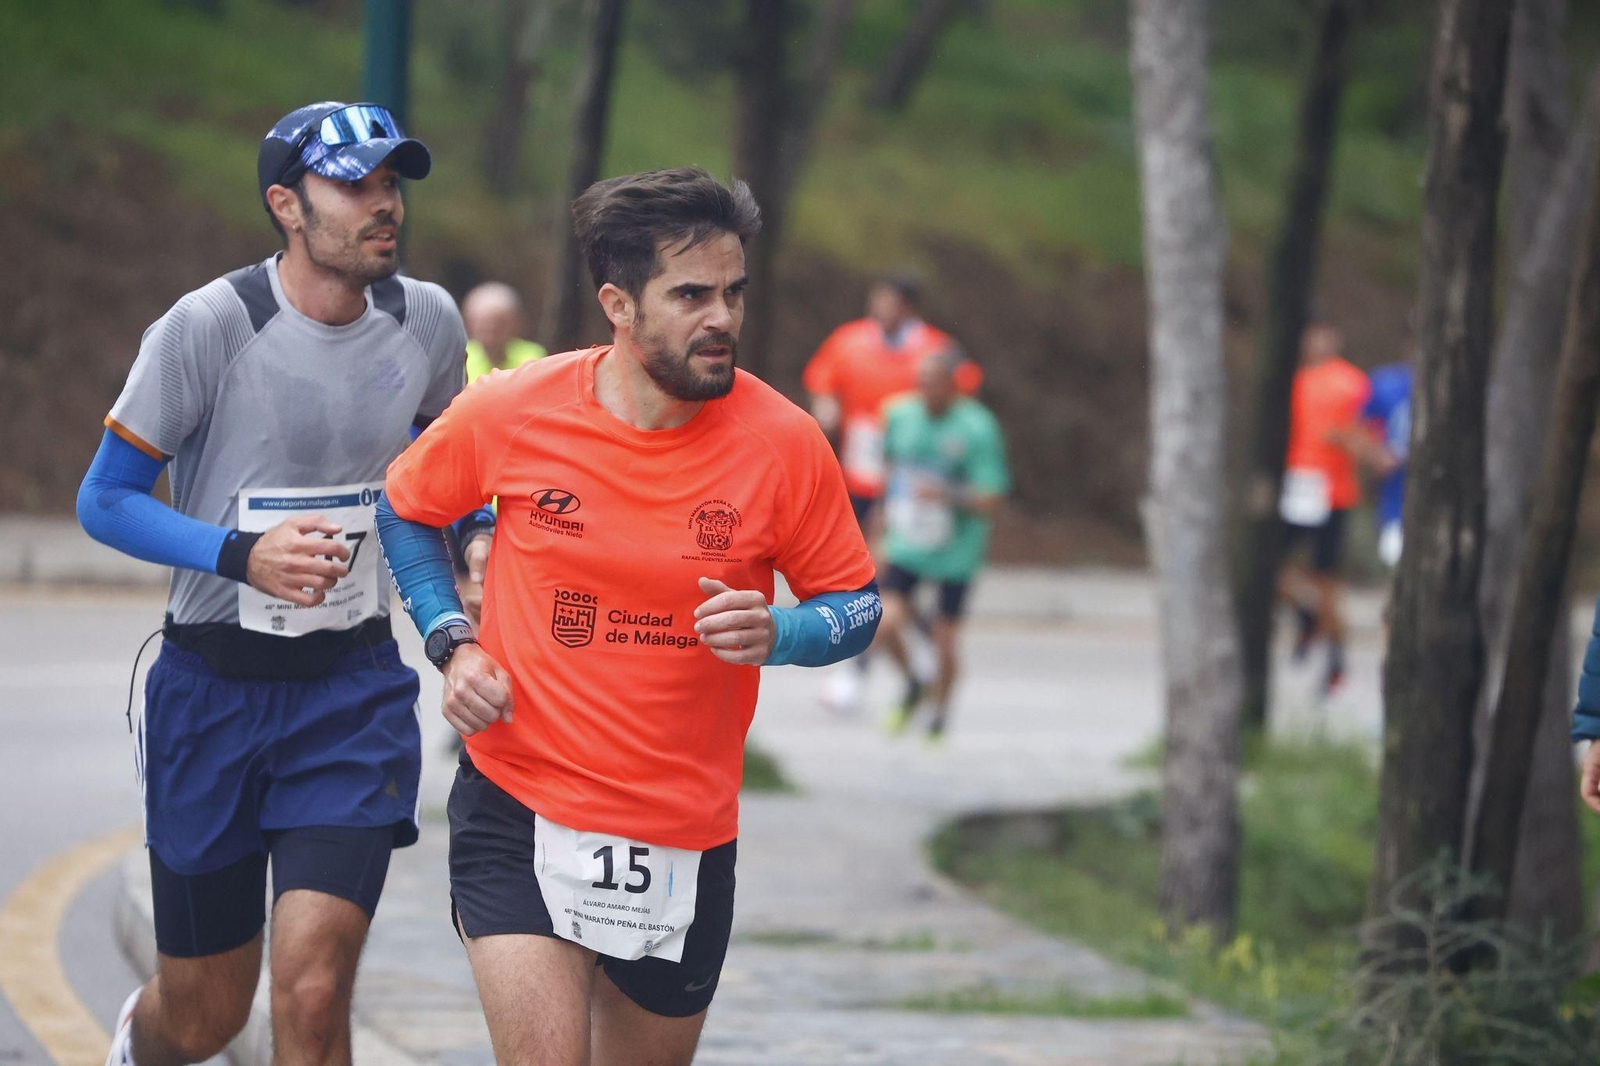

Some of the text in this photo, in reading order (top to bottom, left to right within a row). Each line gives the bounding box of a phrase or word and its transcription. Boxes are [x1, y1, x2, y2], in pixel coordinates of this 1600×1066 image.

[262, 499, 339, 508] www.deporte.malaga.eu
[529, 520, 583, 539] Automóviles Nieto
[530, 510, 584, 531] HYUNDAI
[608, 609, 673, 628] Ciudad
[849, 606, 875, 630] PART
[605, 629, 698, 649] de Málaga
[591, 845, 652, 894] 15
[583, 899, 651, 914] ÁLVARO AMARO MEJÍAS
[573, 910, 584, 919] MINI
[584, 914, 615, 926] MARATÓN
[617, 919, 637, 929] PEÑA
[638, 922, 647, 930] EL
[648, 923, 675, 933] BASTÓN
